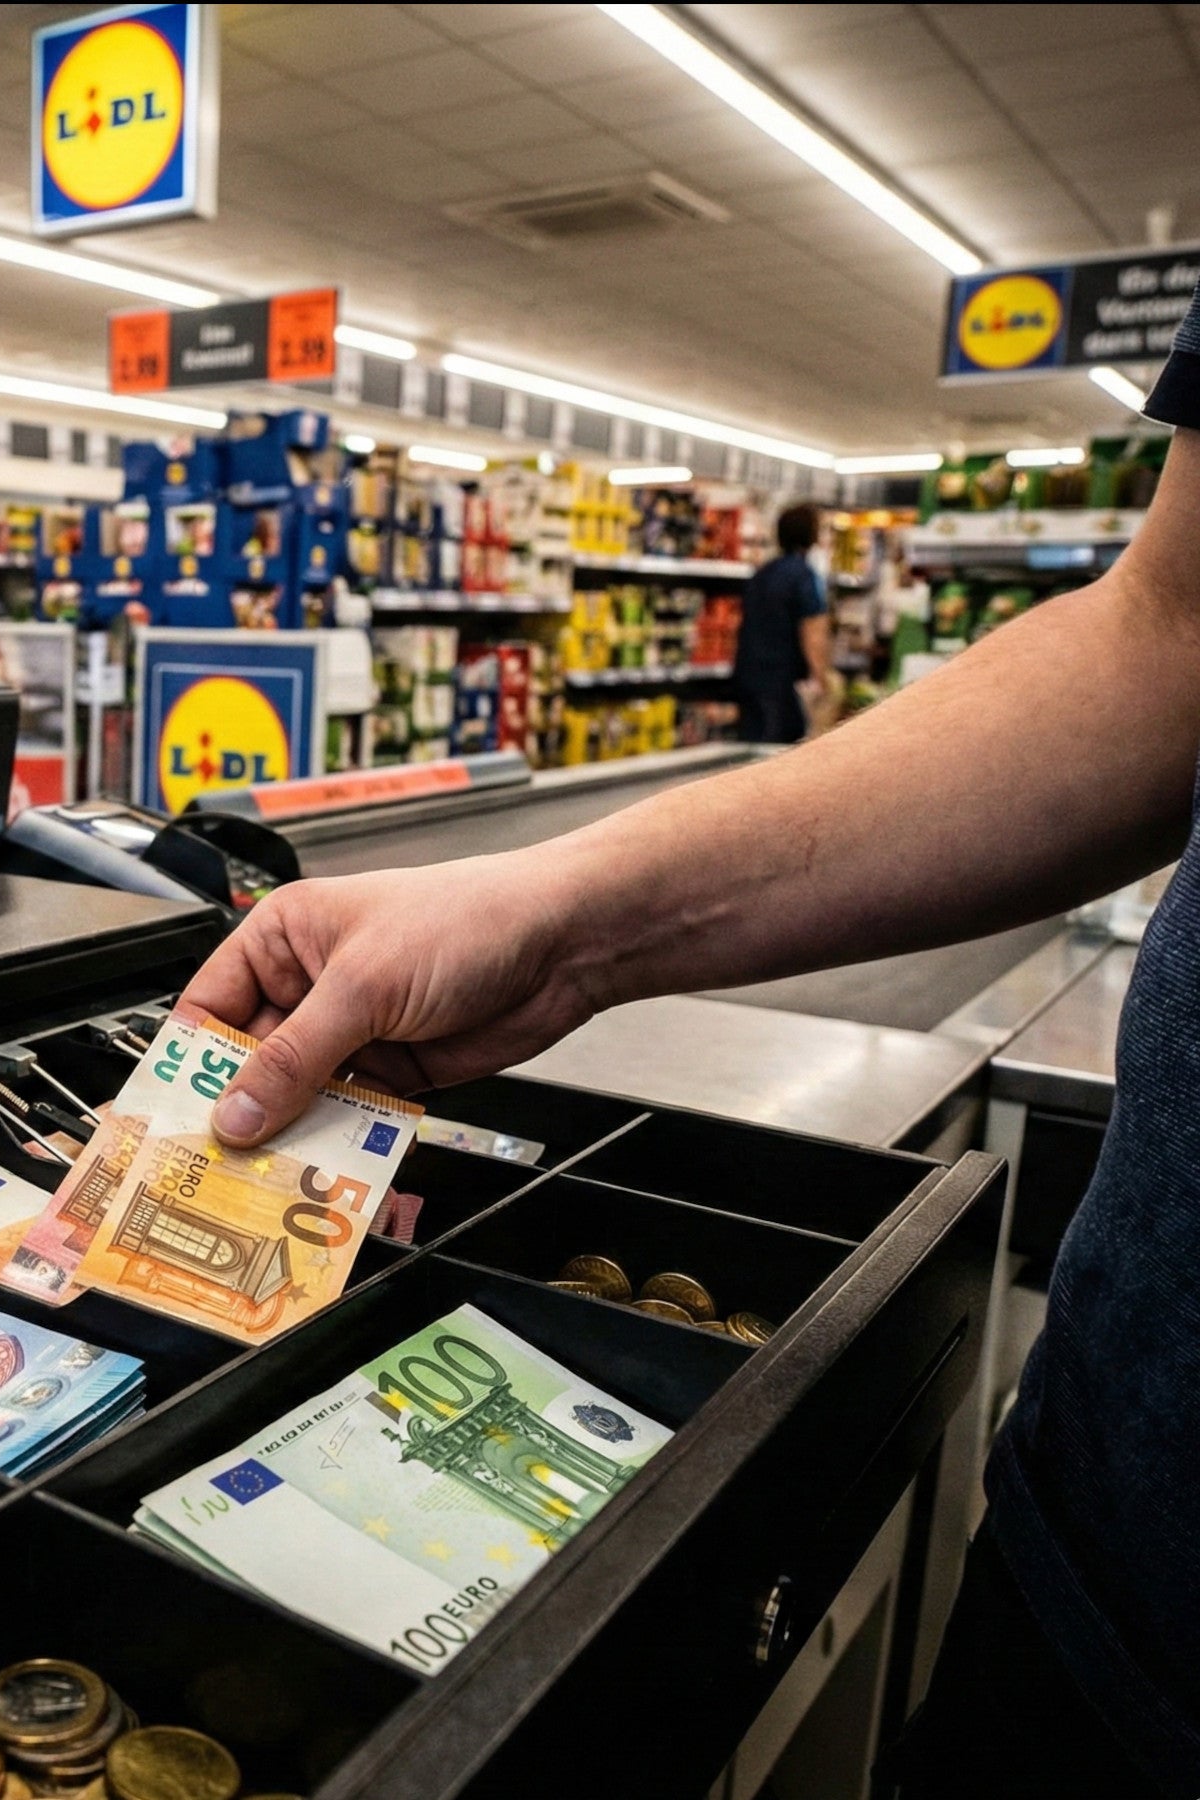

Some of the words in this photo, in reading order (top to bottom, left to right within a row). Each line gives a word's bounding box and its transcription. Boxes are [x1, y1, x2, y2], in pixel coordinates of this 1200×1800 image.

[179, 1152, 210, 1199] EURO
[282, 1164, 372, 1248] 50
[378, 1334, 508, 1422] 100
[390, 1613, 468, 1668] 100
[441, 1576, 499, 1619] EURO
